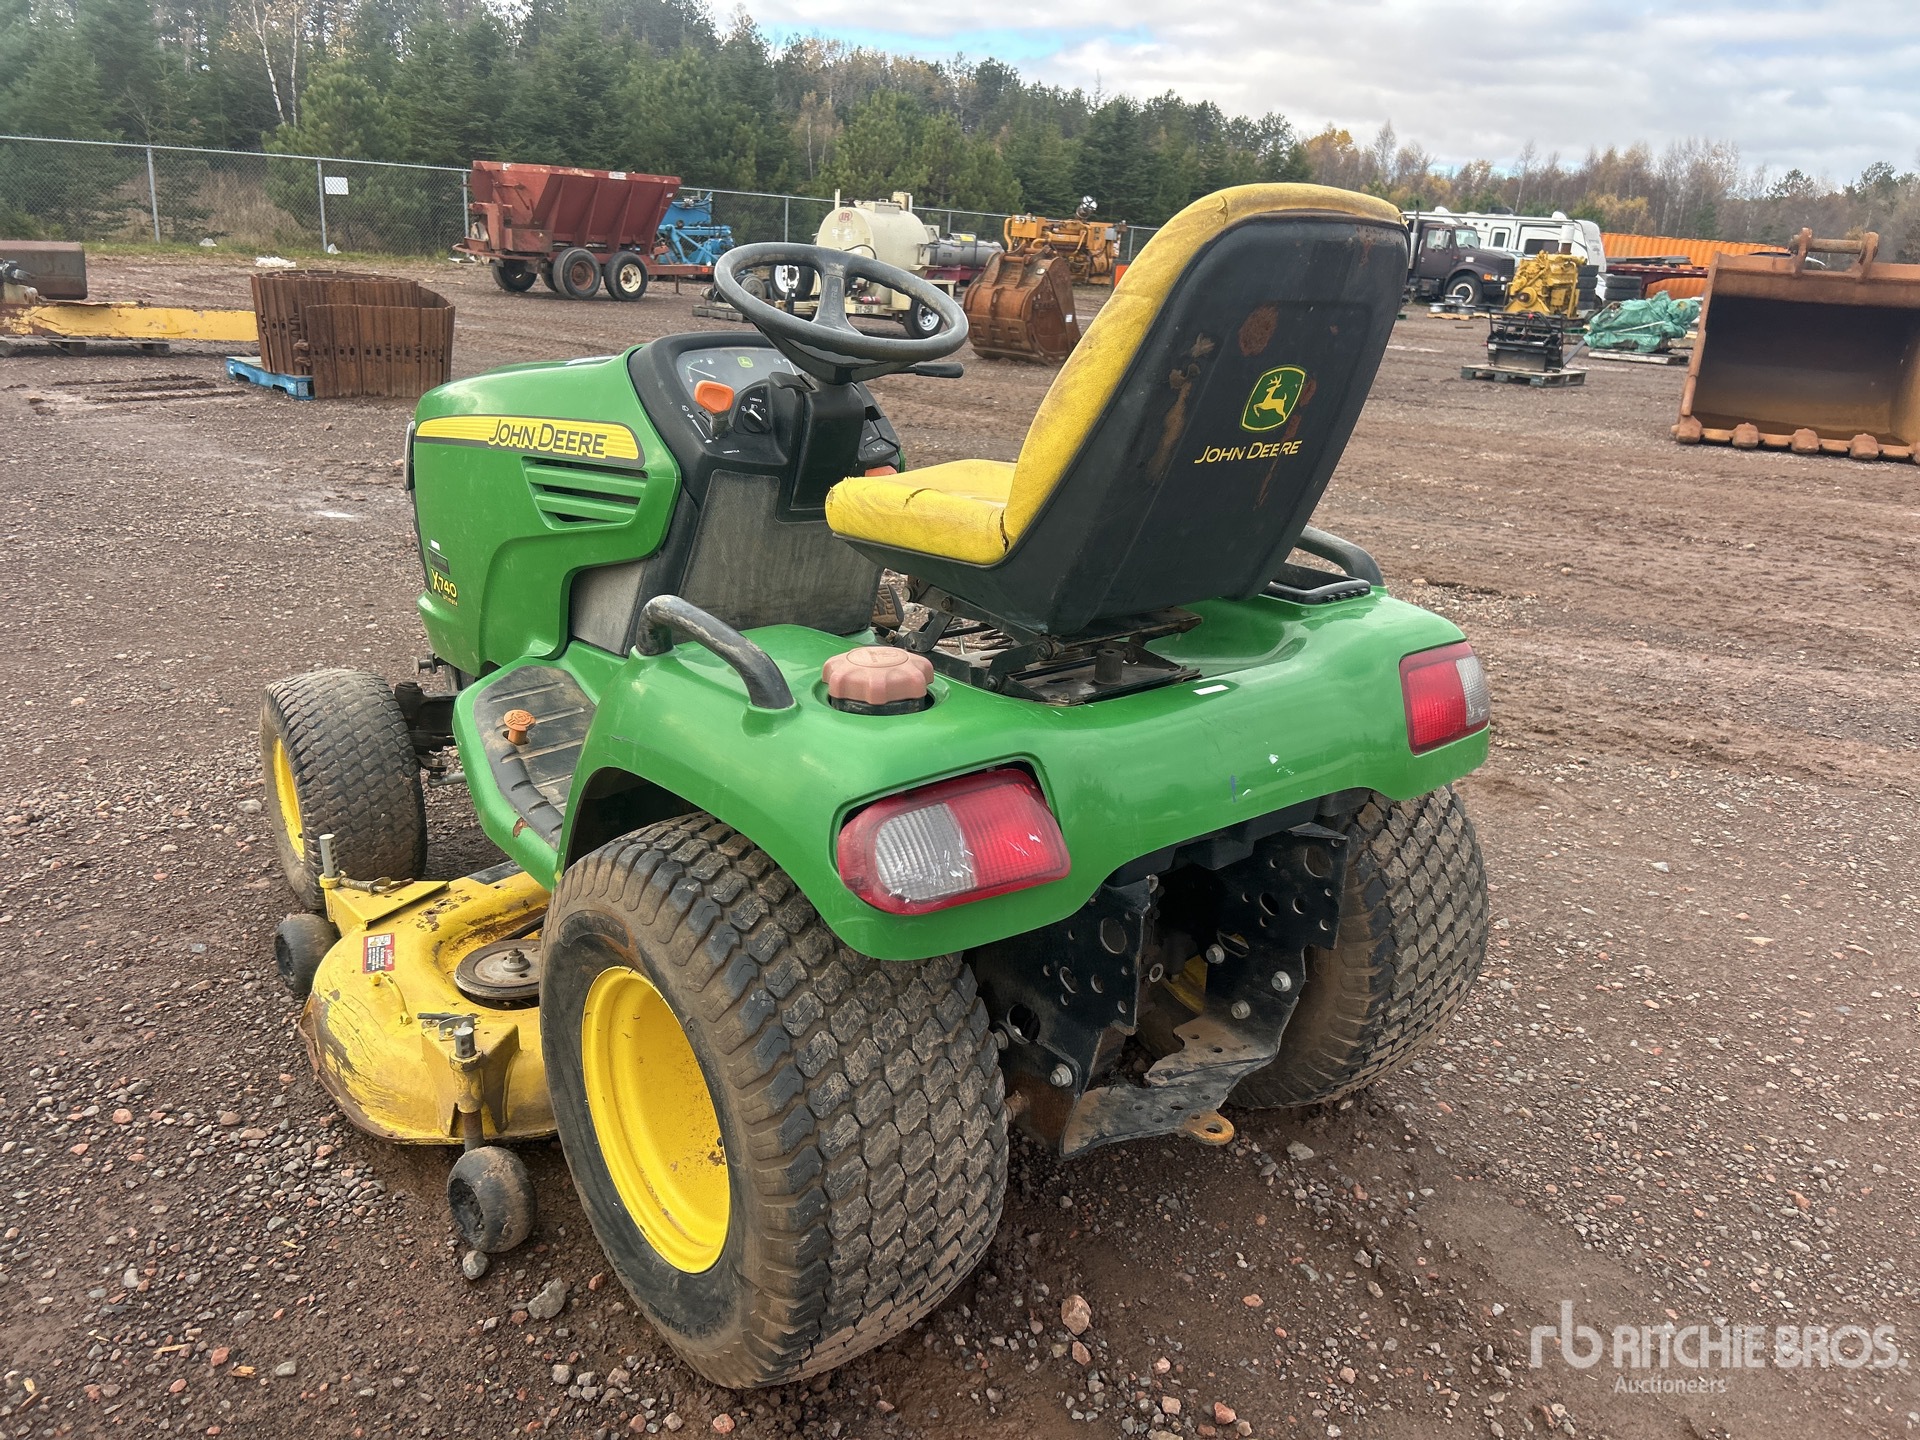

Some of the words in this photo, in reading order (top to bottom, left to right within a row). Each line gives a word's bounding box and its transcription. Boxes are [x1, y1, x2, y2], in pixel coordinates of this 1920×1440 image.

[488, 419, 536, 447] JOHN
[537, 423, 608, 456] DEERE
[1194, 445, 1246, 464] JOHN
[1246, 440, 1303, 460] DEERE
[430, 568, 458, 598] X740
